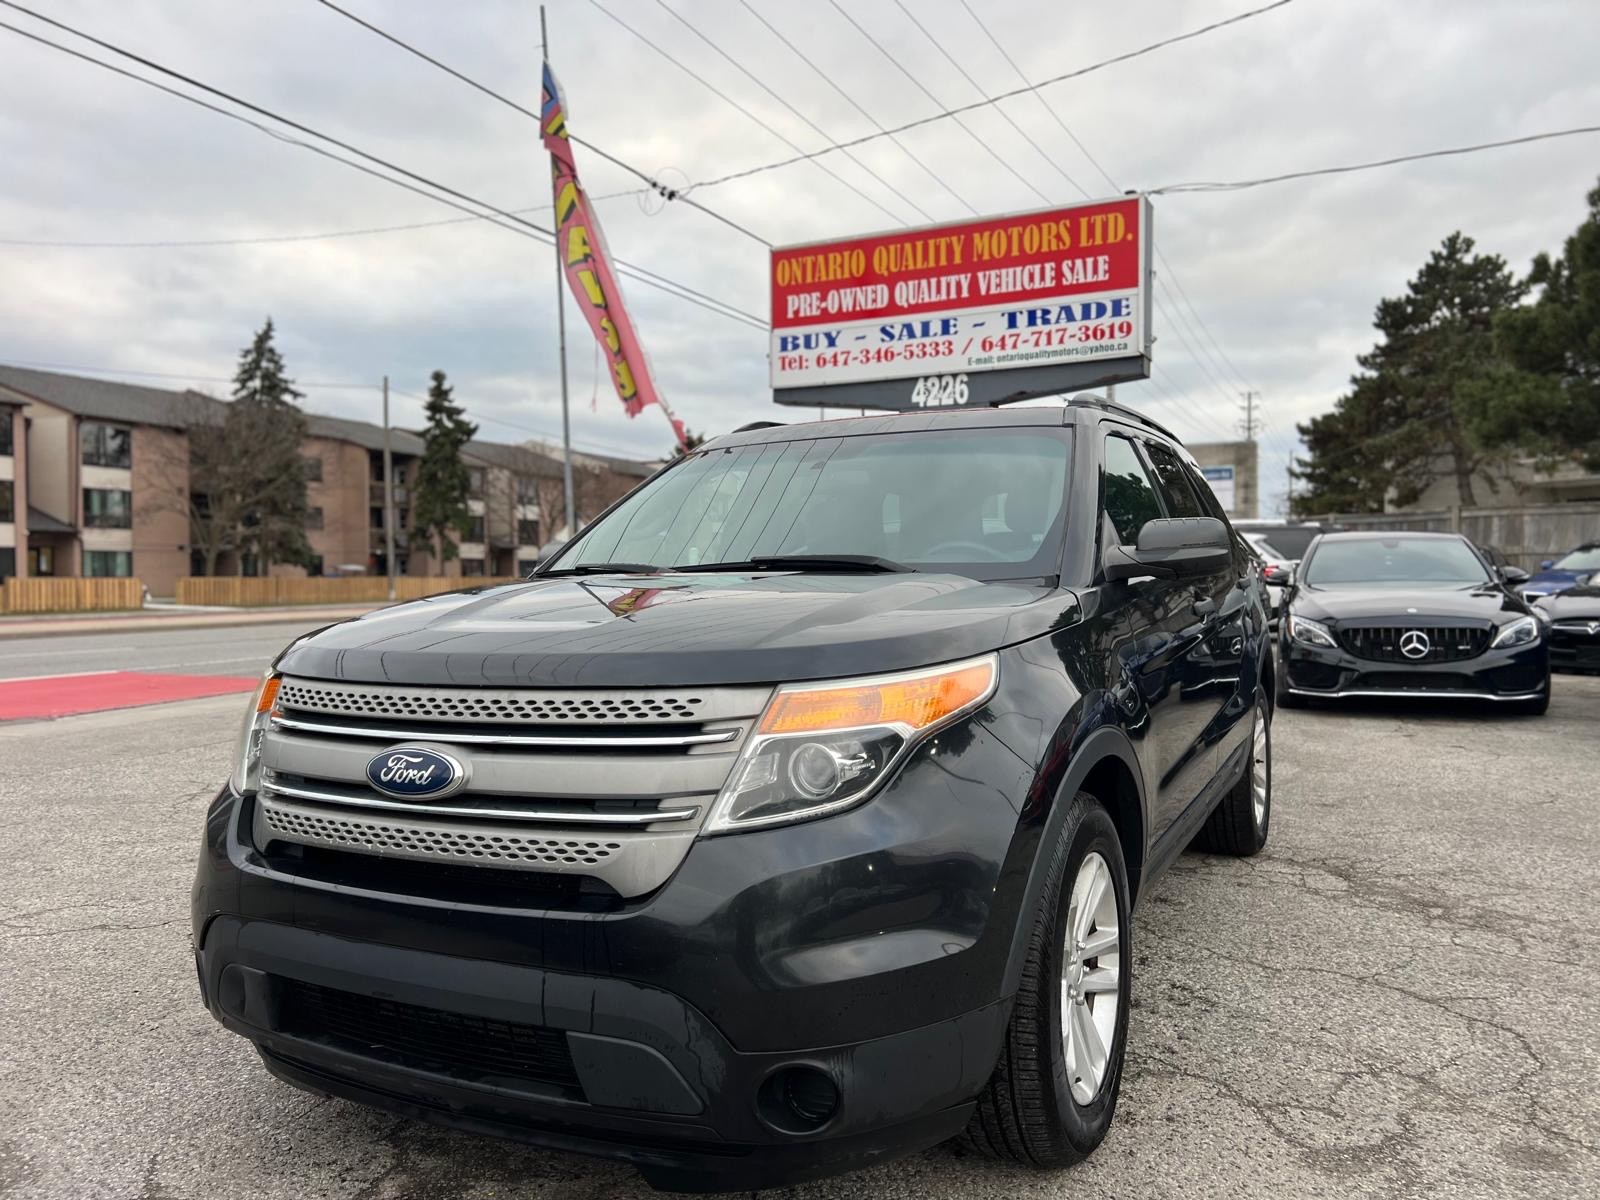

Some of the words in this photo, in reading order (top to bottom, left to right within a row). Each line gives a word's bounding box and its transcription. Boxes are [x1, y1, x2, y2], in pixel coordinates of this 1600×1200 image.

[776, 248, 866, 288] ONTARIO
[873, 234, 965, 277] QUALITY
[972, 219, 1072, 262] MOTORS
[1079, 211, 1134, 248] LTD.
[786, 284, 889, 320] PRE-OWNED
[894, 273, 972, 309] QUALITY
[977, 262, 1056, 296] VEHICLE
[1061, 255, 1110, 286] SALE
[778, 355, 810, 372] Tel:
[816, 339, 955, 369] 647-346-5333
[981, 320, 1133, 353] 647-717-3619
[779, 330, 842, 353] BUY
[880, 317, 959, 343] SALE
[1001, 298, 1133, 330] TRADE
[967, 357, 996, 367] E-mail:
[996, 342, 1129, 364] ontarioqualitymotors@yahoo.ca
[911, 373, 970, 408] 4226
[380, 754, 436, 786] Ford
